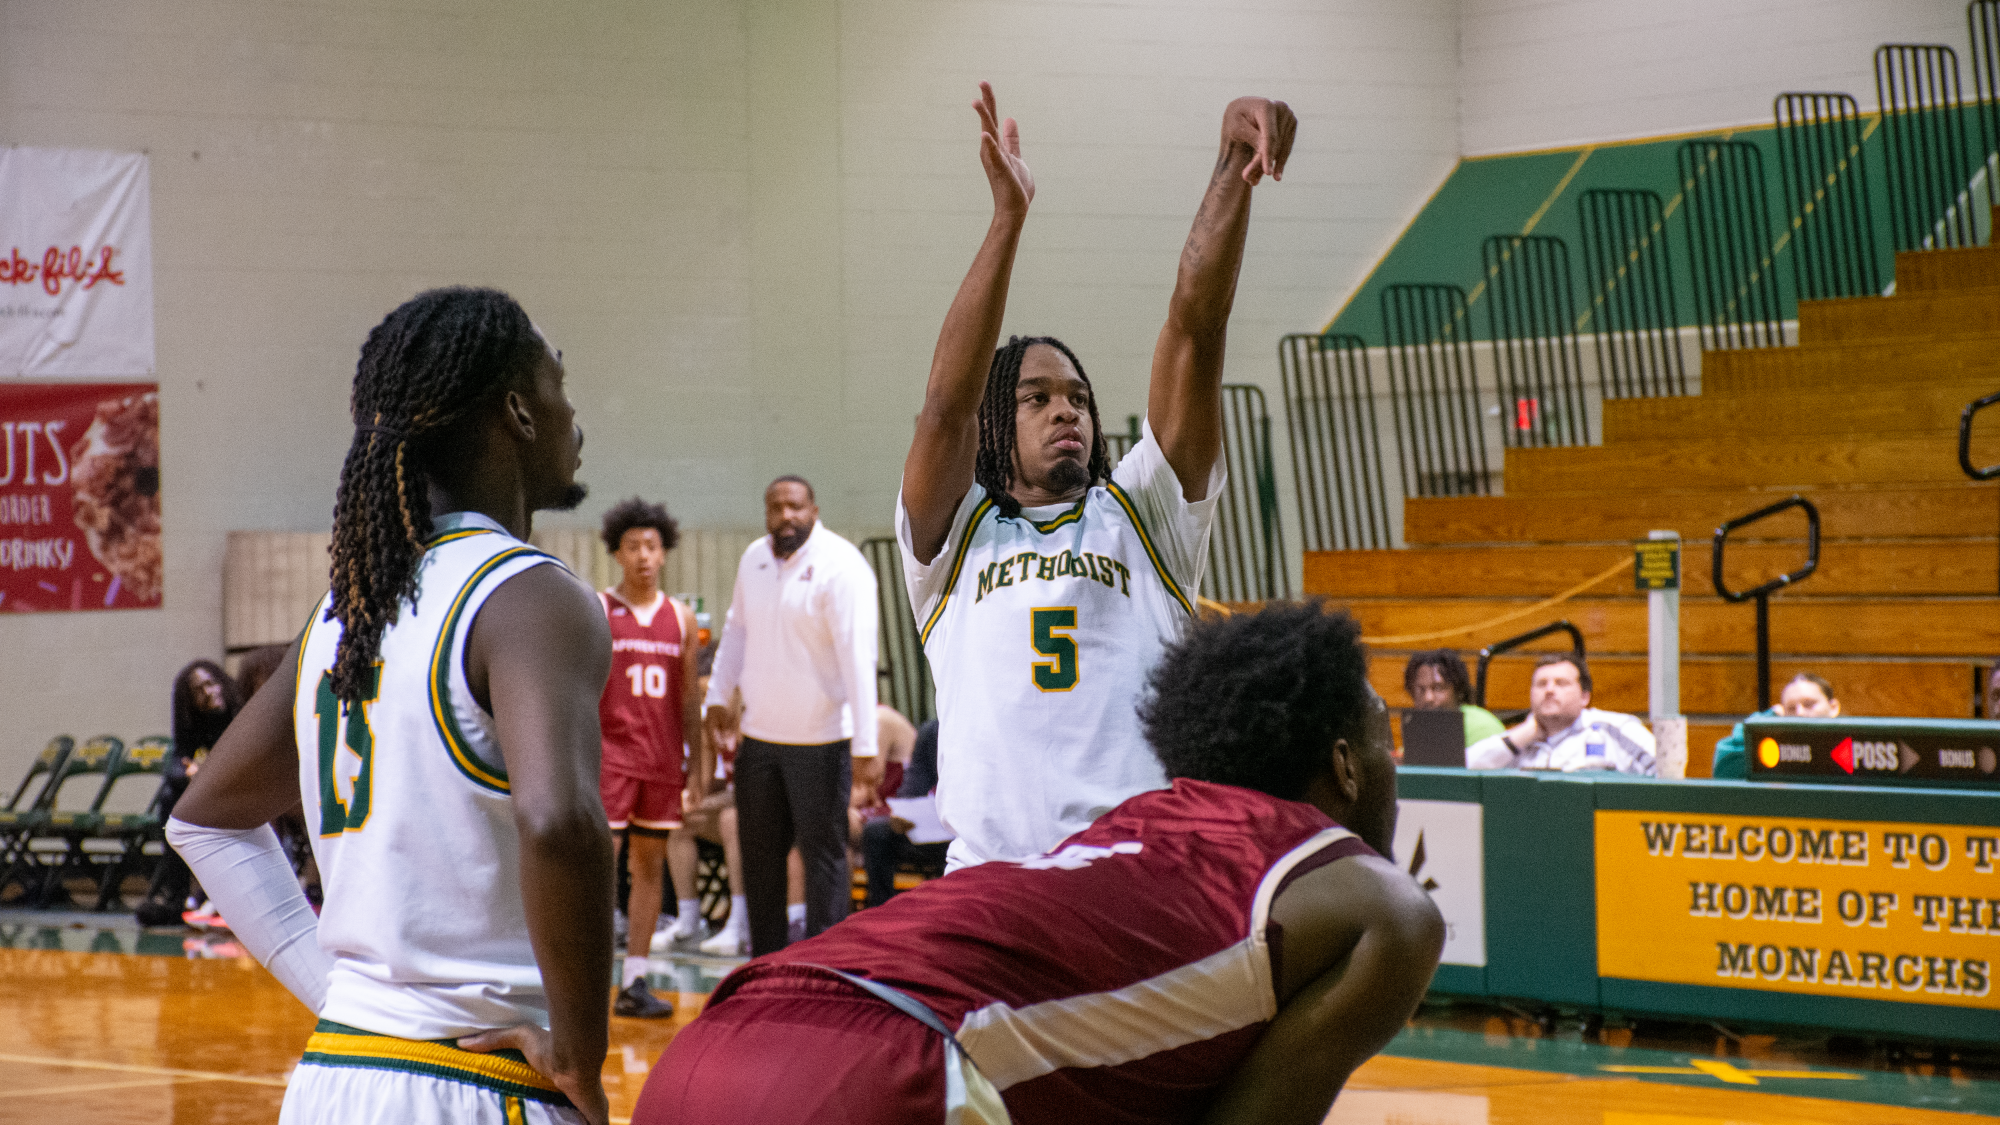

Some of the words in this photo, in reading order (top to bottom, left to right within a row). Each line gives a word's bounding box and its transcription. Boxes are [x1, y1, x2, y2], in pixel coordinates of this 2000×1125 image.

[975, 550, 1131, 604] METHODIST
[1030, 606, 1080, 693] 5
[625, 663, 667, 699] 10
[313, 660, 386, 840] 15
[1779, 744, 1812, 763] BONUS
[1852, 741, 1899, 771] POSS
[1939, 749, 1976, 768] BONUS
[1640, 821, 1870, 867] WELCOME
[1883, 831, 1951, 872] TO
[1688, 882, 1822, 924] HOME
[1837, 889, 1899, 930] OF
[1716, 941, 1991, 998] MONARCHS
